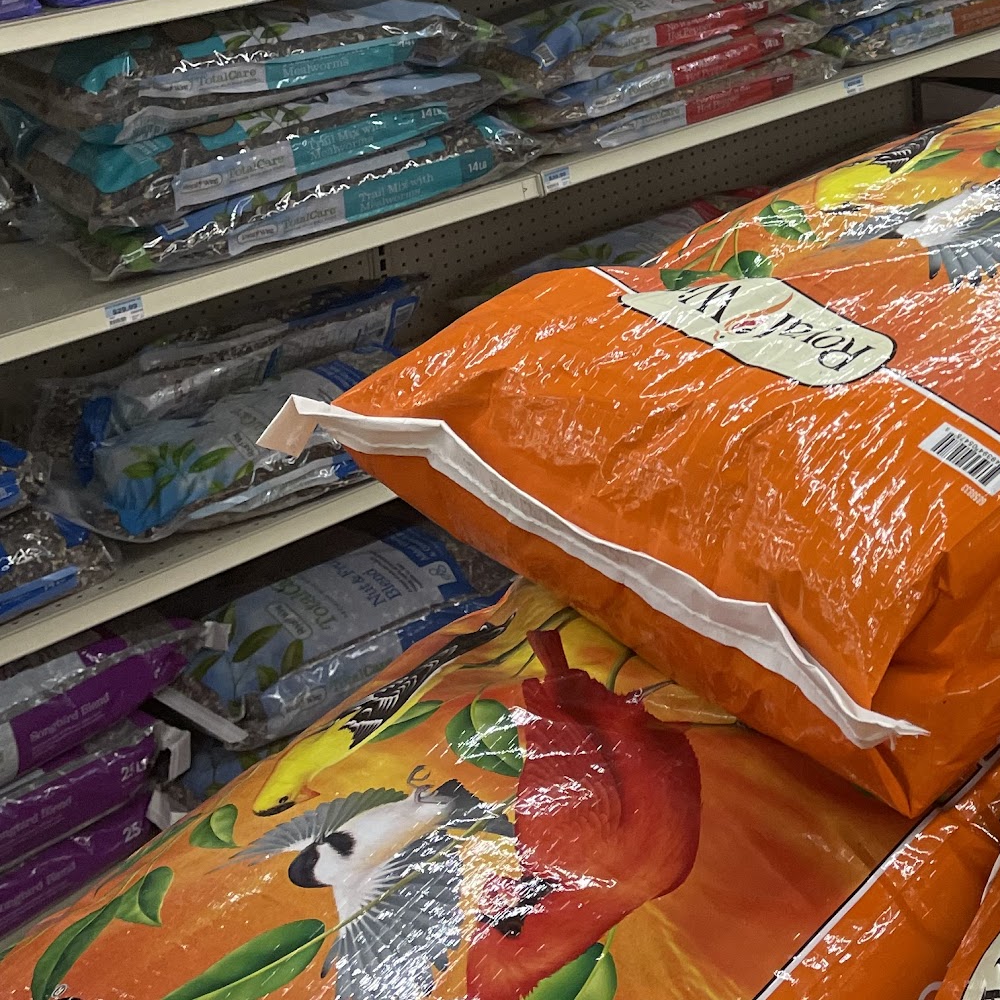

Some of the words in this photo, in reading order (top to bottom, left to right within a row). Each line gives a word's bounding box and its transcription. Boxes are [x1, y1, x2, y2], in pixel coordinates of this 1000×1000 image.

[467, 159, 489, 174] 14LB
[363, 567, 403, 601] Blend
[29, 709, 79, 742] Songbird
[80, 692, 111, 714] Blend
